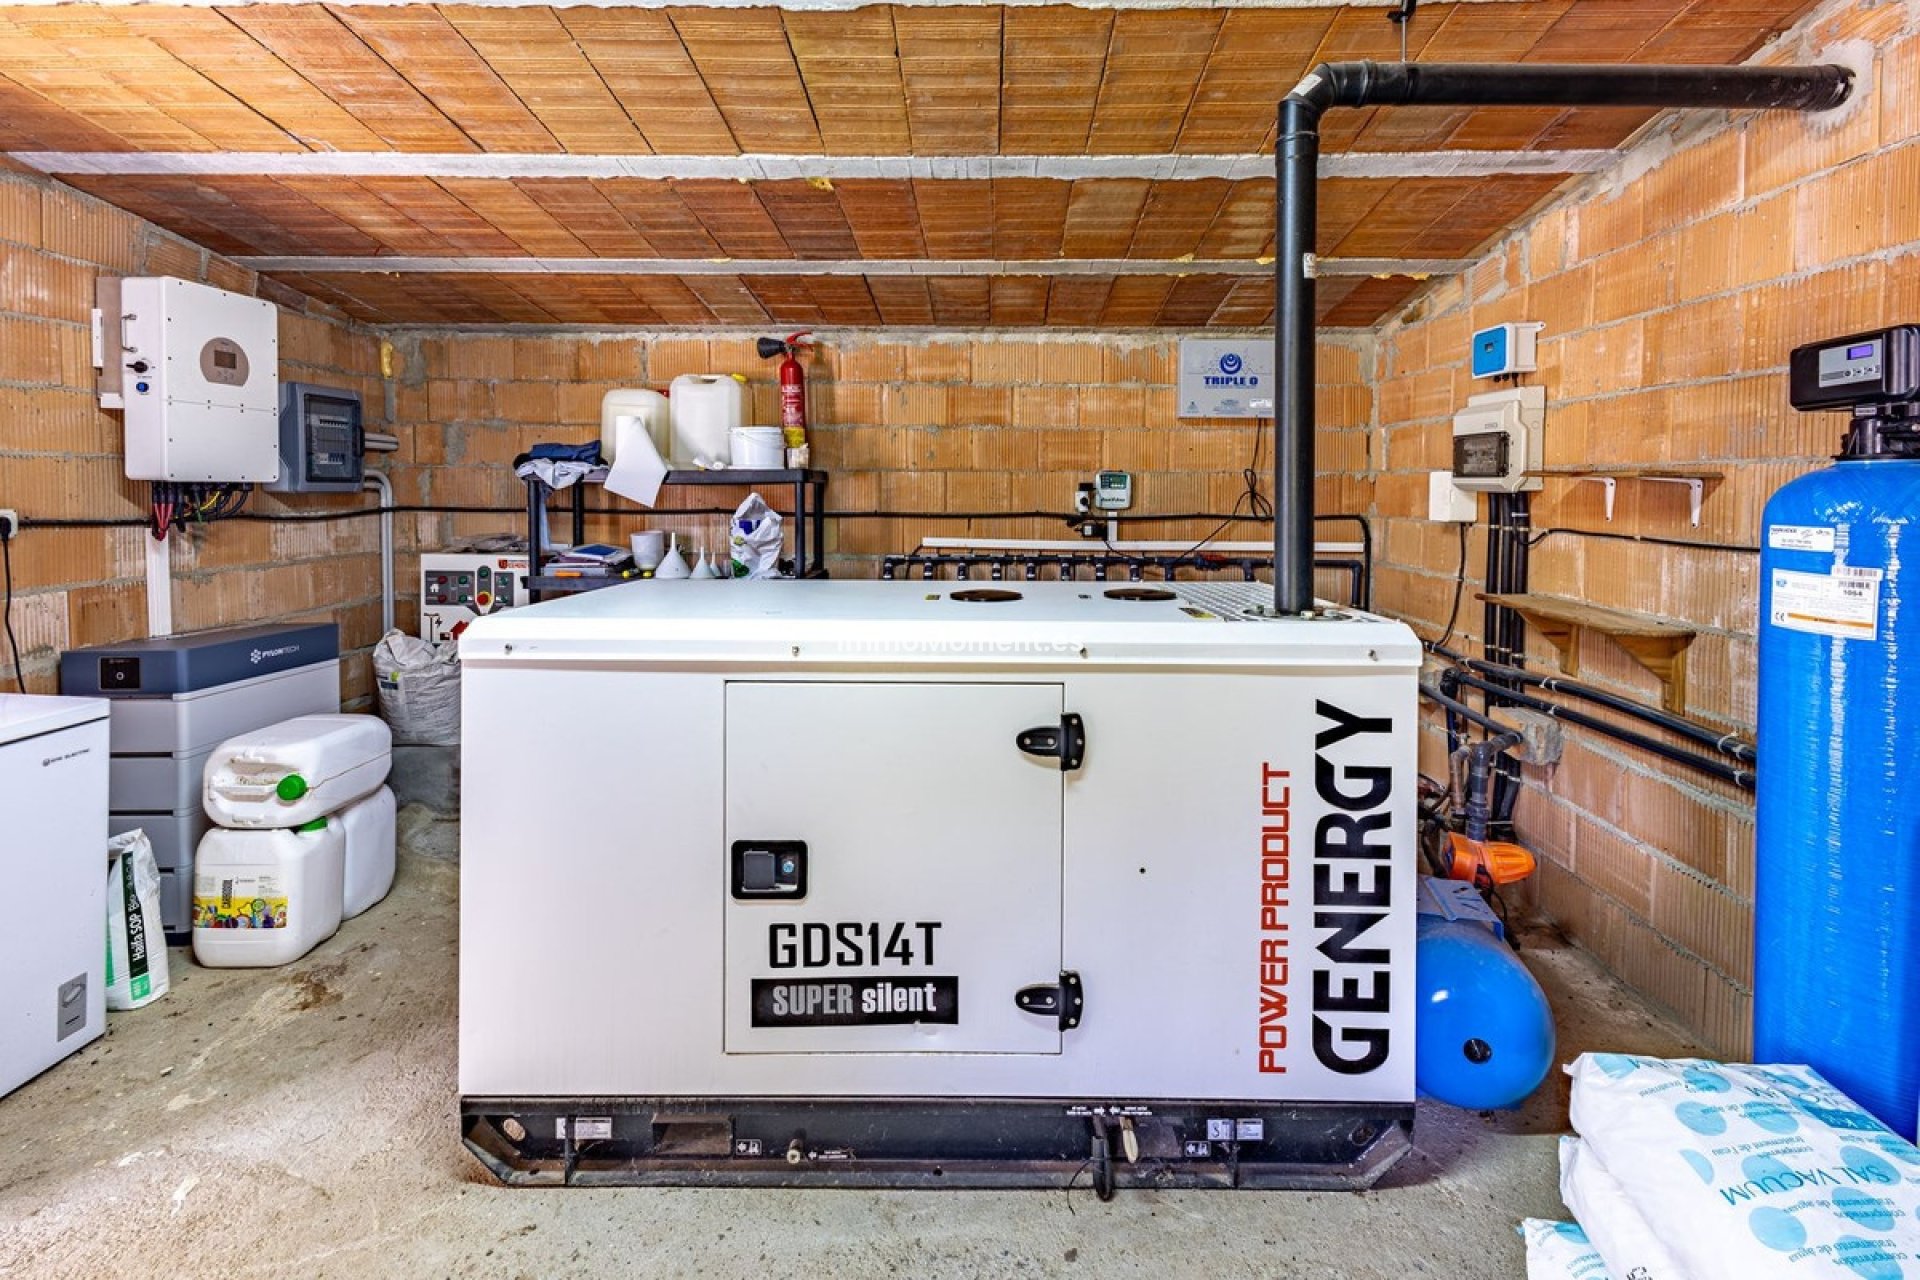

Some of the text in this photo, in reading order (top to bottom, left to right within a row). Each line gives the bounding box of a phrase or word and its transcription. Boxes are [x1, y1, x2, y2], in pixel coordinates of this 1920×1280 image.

[1203, 376, 1246, 385] TRIPLE
[1312, 699, 1393, 1075] GENERGY
[1259, 762, 1291, 1073] POWER PRODUCT
[132, 933, 145, 962] Haifa
[768, 922, 942, 969] GDS14T
[772, 981, 937, 1016] SUPER silent
[1719, 1165, 1891, 1206] SAL VACUUM
